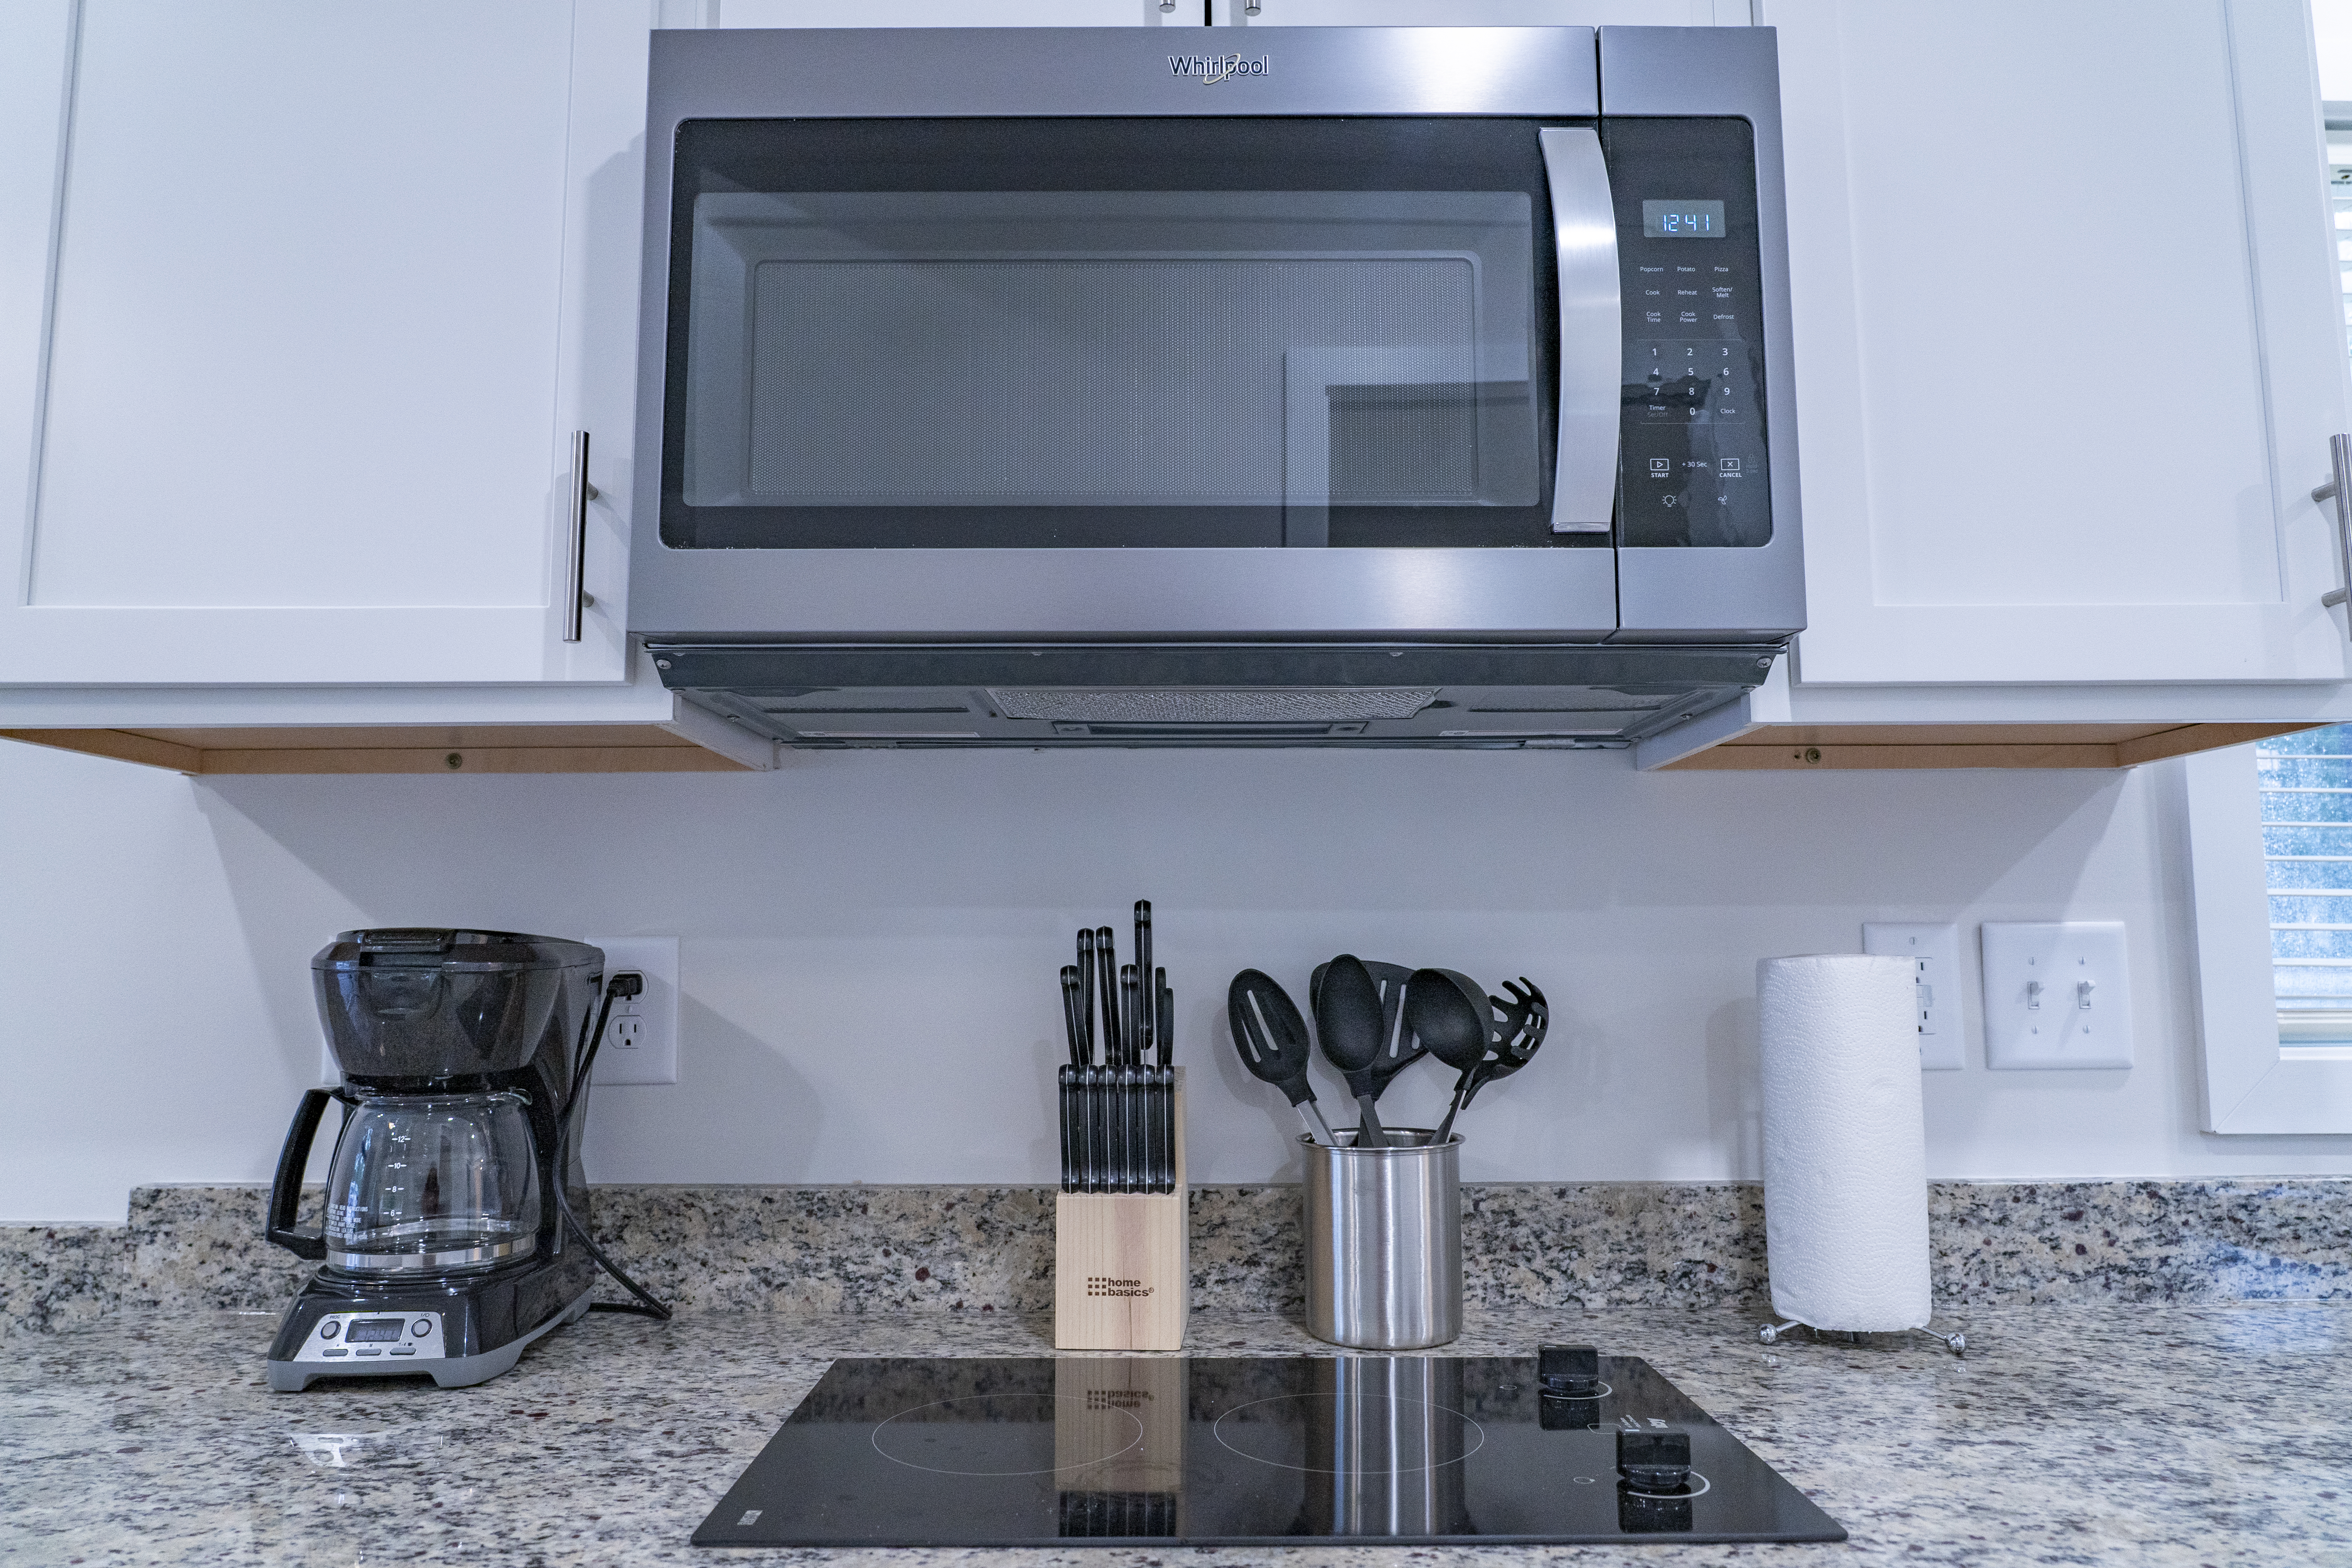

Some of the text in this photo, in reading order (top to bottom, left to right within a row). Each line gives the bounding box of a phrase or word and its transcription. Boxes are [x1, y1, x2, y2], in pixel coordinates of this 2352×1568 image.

[1168, 55, 1269, 81] Whirlpool
[1690, 407, 1695, 416] 0
[1108, 1278, 1141, 1287] home
